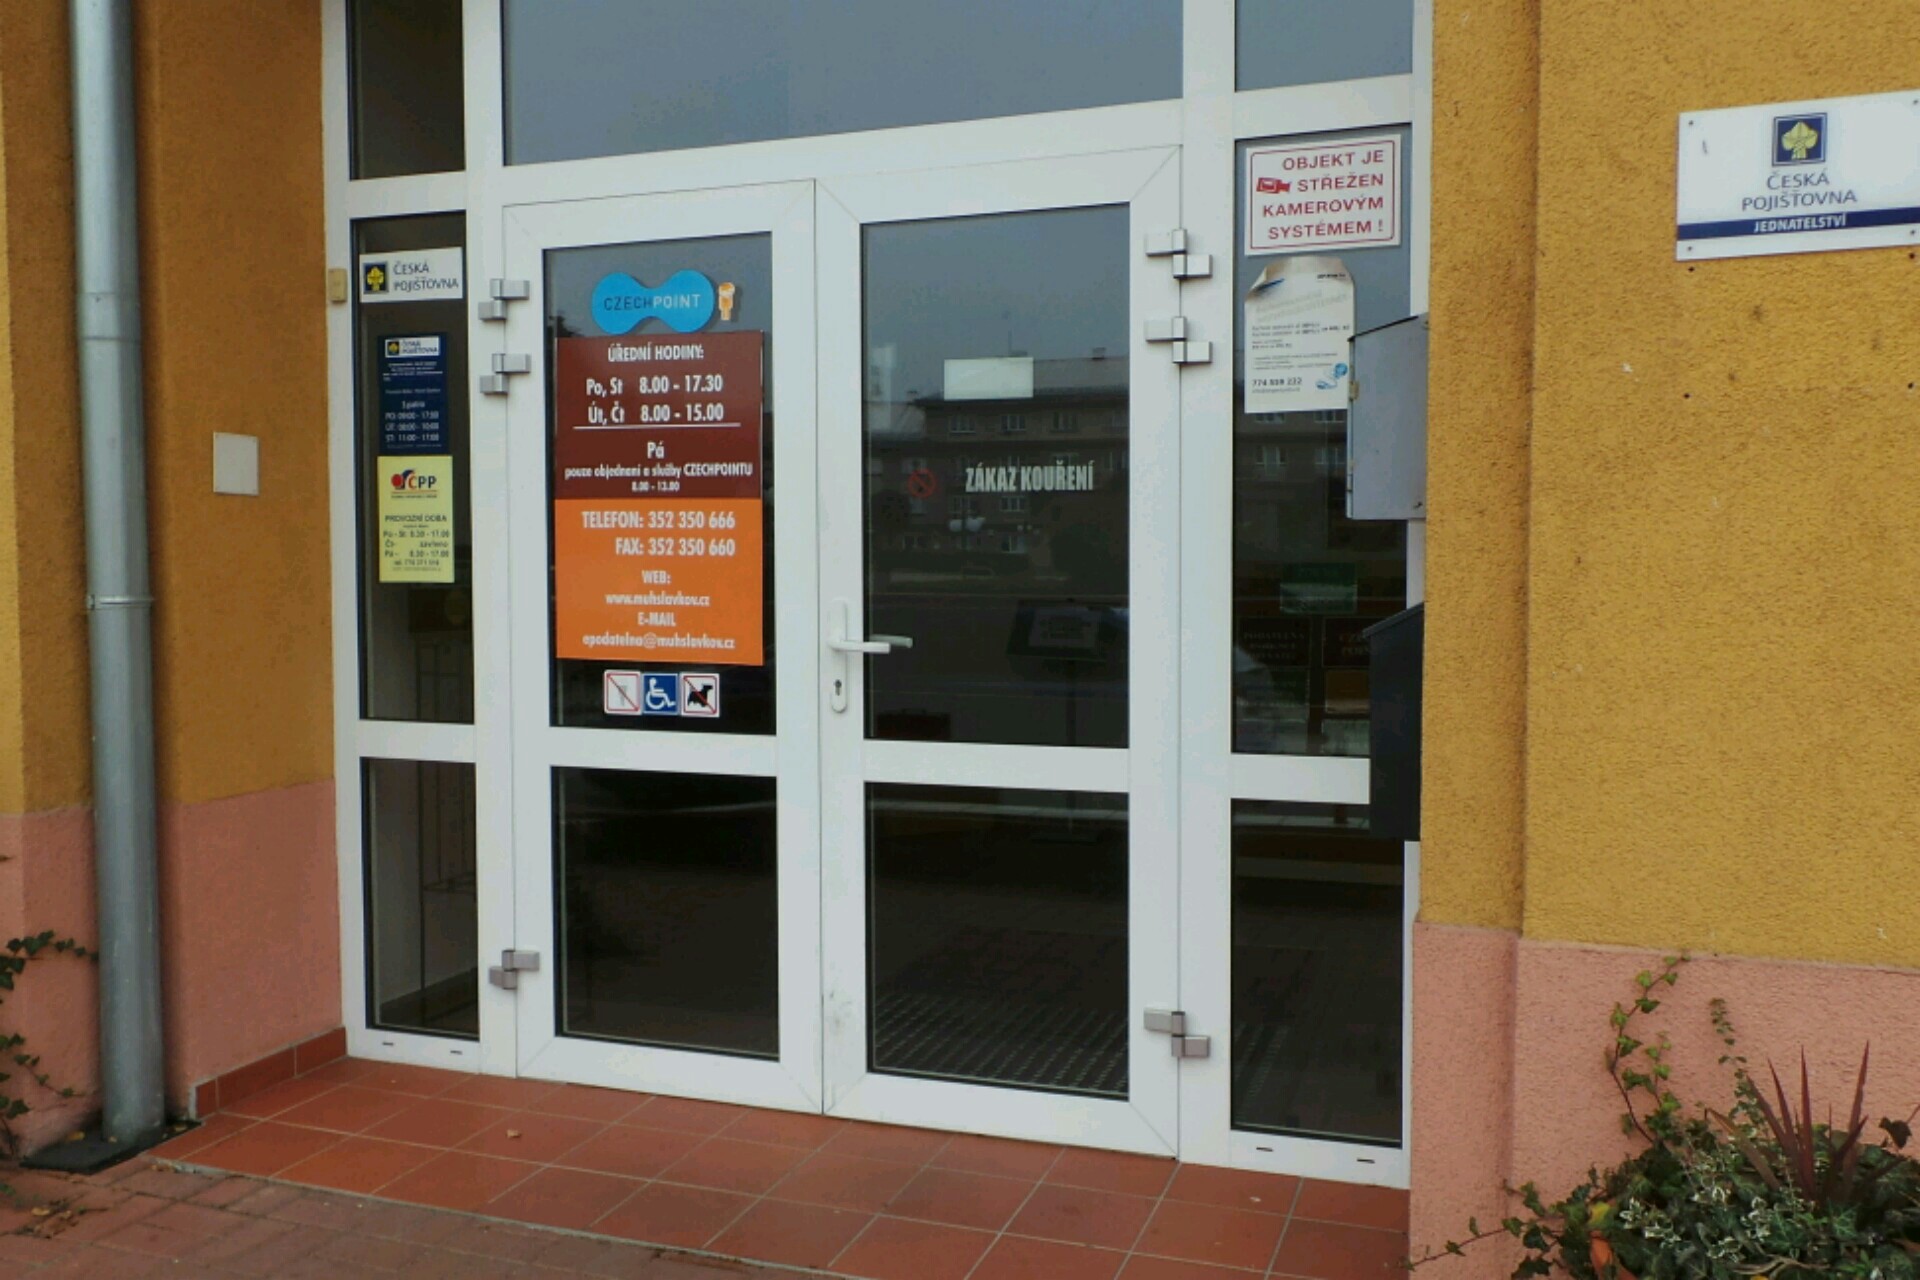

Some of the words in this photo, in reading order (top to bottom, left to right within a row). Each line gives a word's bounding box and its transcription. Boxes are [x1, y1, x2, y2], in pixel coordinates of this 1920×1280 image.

[1282, 151, 1355, 171] OBJEKT
[1361, 149, 1384, 165] JE
[1297, 171, 1384, 193] STŘEŽEN
[1766, 167, 1829, 190] ČESKÁ
[1262, 194, 1384, 218] KAMEROVÝM
[1742, 189, 1857, 212] POJIŠŤOVNA
[1268, 217, 1372, 240] SYSTÉMEM
[1753, 211, 1846, 234] JEDNATELSTVÍ
[393, 260, 429, 275] ČESKÁ
[393, 276, 459, 293] POJIŠŤOVNA
[608, 342, 651, 362] ÚŘEDNÍ
[655, 344, 704, 360] HODINY:
[586, 378, 607, 397] Po,
[610, 377, 623, 394] St
[639, 376, 669, 394] 8.00
[684, 374, 723, 393] 17.30
[588, 402, 607, 425] Út,
[611, 401, 625, 423] Čt
[640, 404, 670, 422] 8.00
[686, 403, 724, 421] 15.00
[647, 441, 664, 458] Pá
[684, 463, 752, 478] CZECHPOINTU
[965, 462, 1017, 493] ZÁKAZ
[1021, 460, 1095, 492] KOUŘENÍ
[385, 514, 422, 523] PROVOZNÍ
[581, 511, 644, 528] TELEFON:
[648, 511, 674, 528] 352
[679, 511, 704, 528] 350
[709, 511, 735, 528] 666
[615, 538, 644, 555] FAX:
[648, 538, 674, 555] 352
[679, 538, 704, 556] 350
[709, 539, 735, 556] 660
[642, 570, 671, 584] WEB:
[638, 612, 676, 627] E-MAIL
